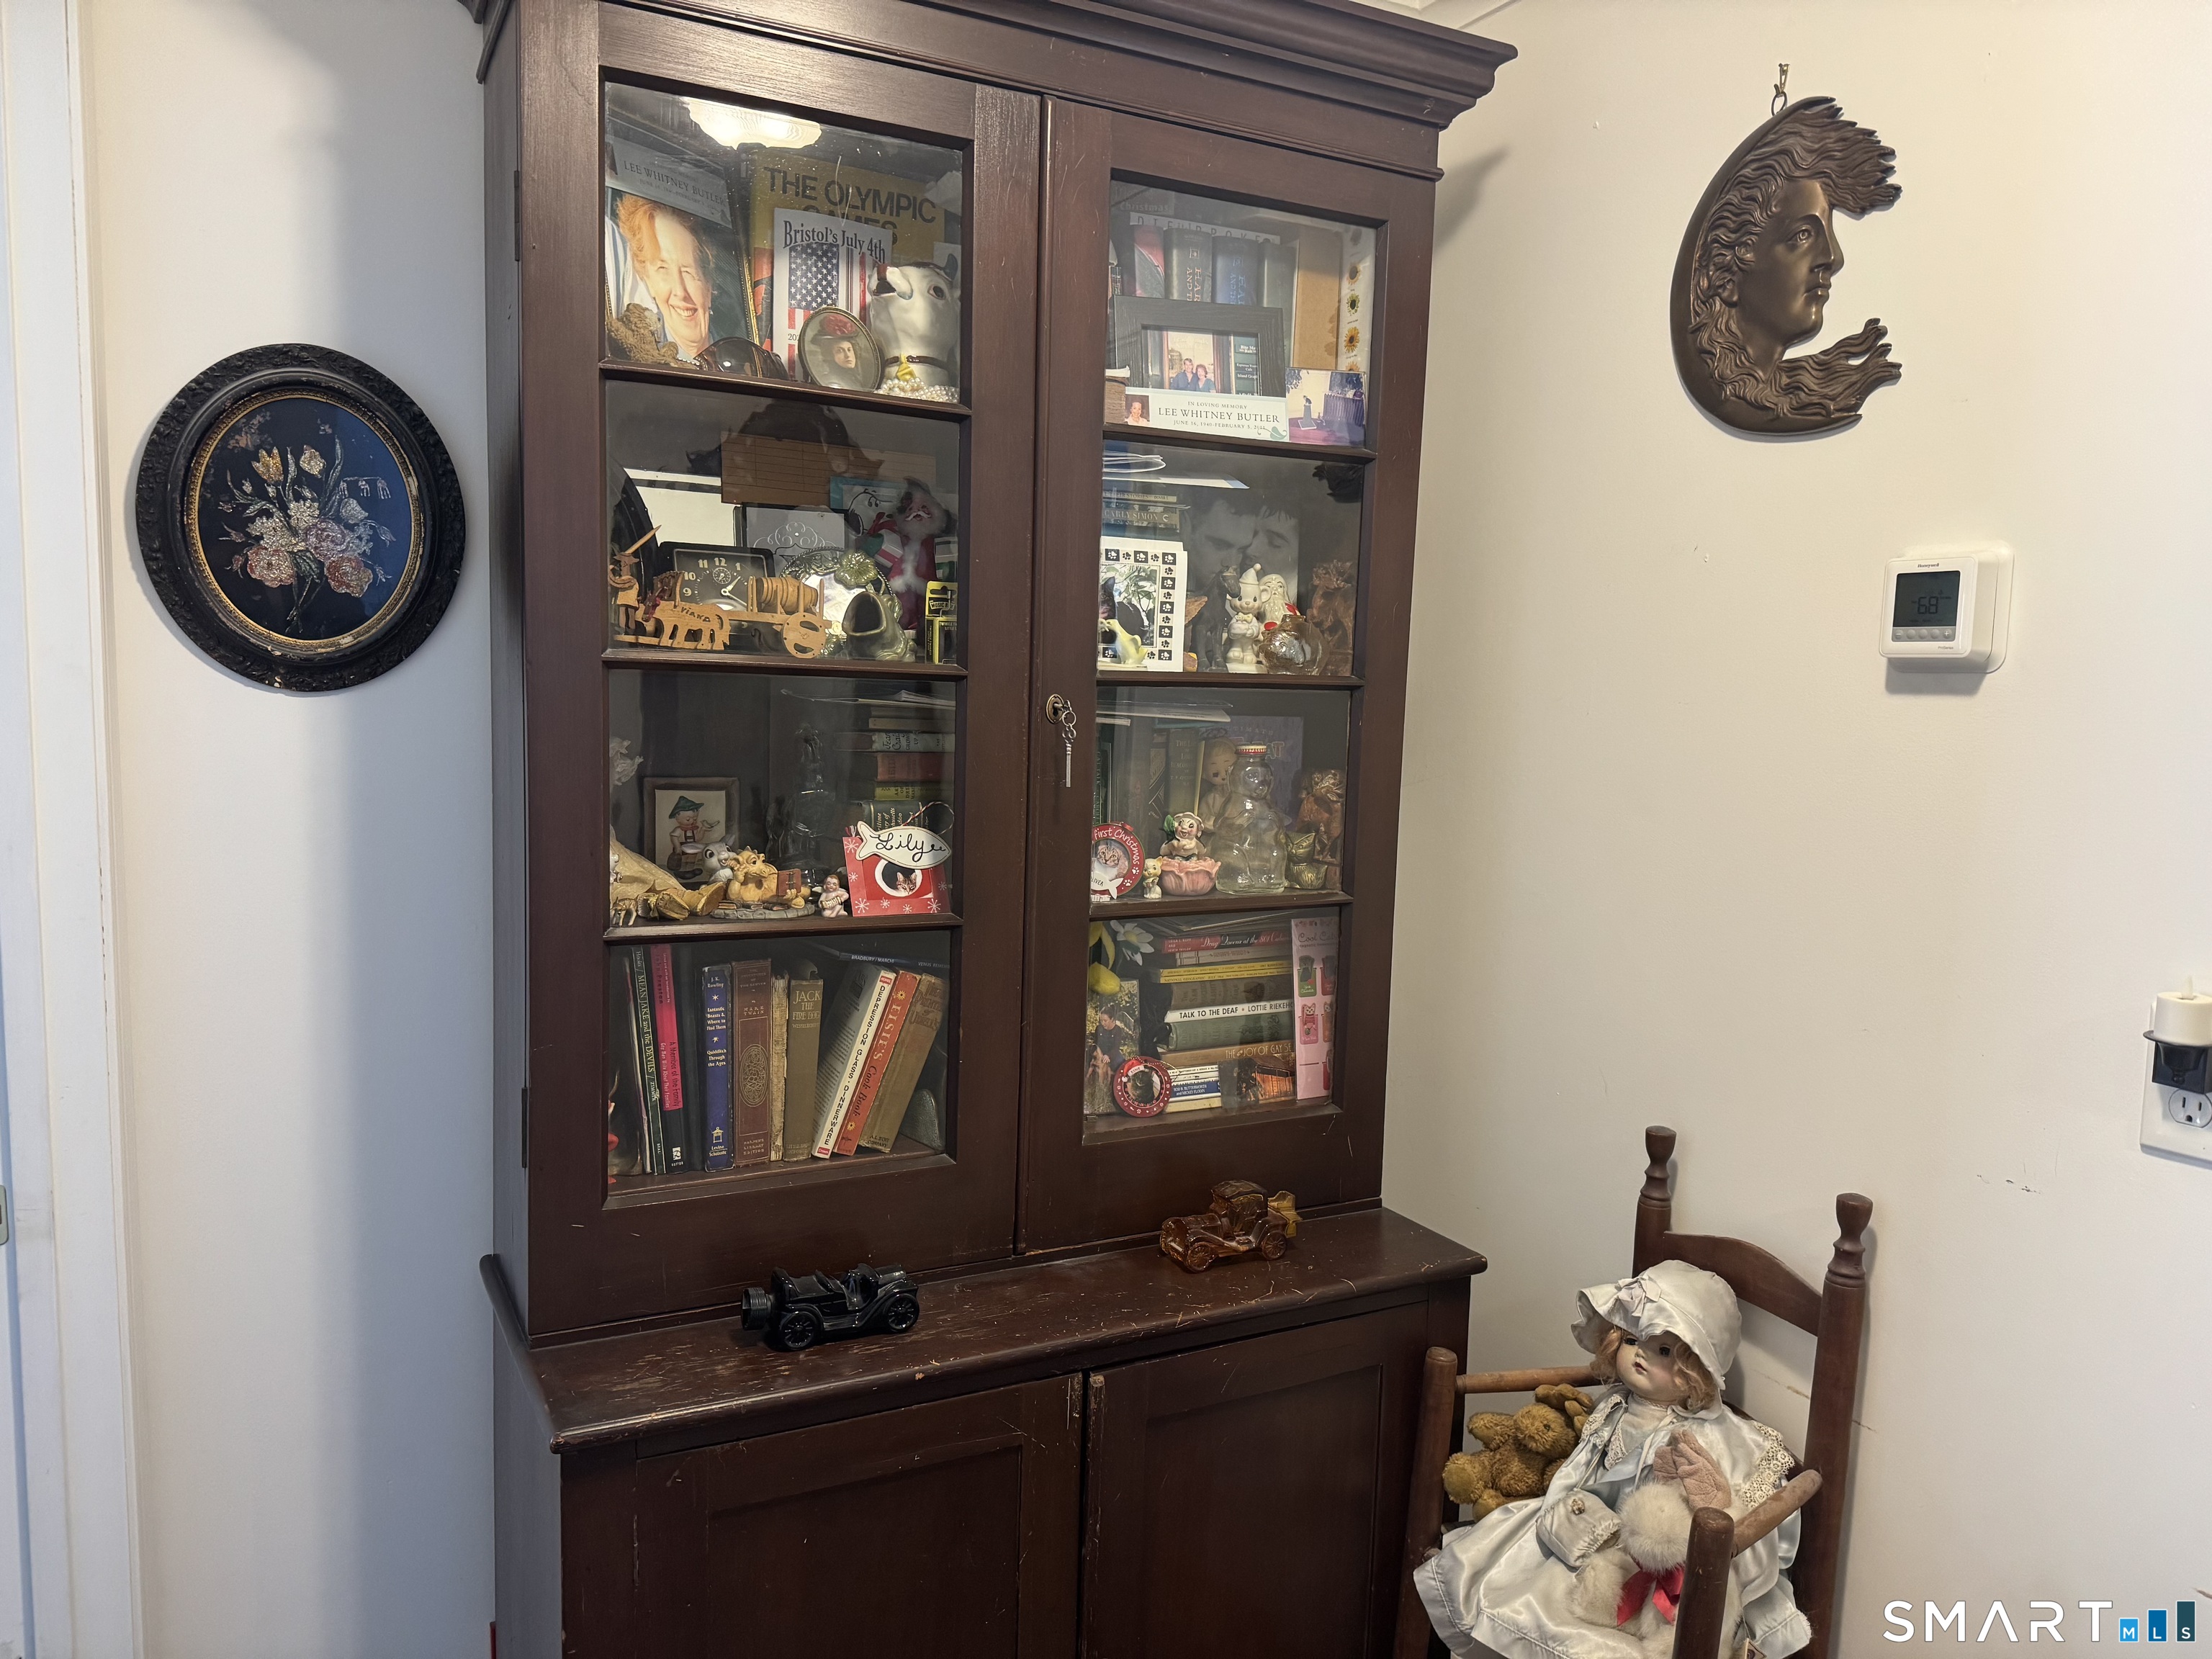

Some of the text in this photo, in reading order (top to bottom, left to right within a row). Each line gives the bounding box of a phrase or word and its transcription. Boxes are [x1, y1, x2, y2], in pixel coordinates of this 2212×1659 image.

[624, 161, 642, 174] LEE
[644, 168, 689, 192] WHITNEY
[764, 166, 818, 201] THE
[824, 180, 936, 223] OLYMPIC
[783, 220, 837, 248] Bristol's
[841, 230, 866, 255] July
[867, 237, 885, 264] 4th
[1159, 408, 1280, 423] LEE WHITNEY BUTLER
[1105, 510, 1130, 518] CARLY
[698, 559, 708, 568] 11
[714, 557, 727, 566] 12
[735, 562, 741, 571] 1
[684, 572, 696, 580] 10
[683, 588, 692, 596] 9
[1917, 595, 1939, 614] 68
[870, 832, 946, 863] Lily
[1114, 830, 1140, 865] Christmas
[1200, 938, 1219, 949] Drag
[1220, 934, 1242, 946] Queens
[1298, 932, 1317, 943] Cool
[637, 975, 646, 998] MEAN
[793, 990, 821, 1004] JACK
[801, 1002, 814, 1010] THE
[639, 999, 649, 1020] JAKE
[860, 985, 886, 1046] DEPRESSION
[645, 1046, 655, 1072] DEVILS
[853, 1002, 902, 1117] ELSIE'S Cook Book
[1226, 1050, 1236, 1059] THE
[1243, 1047, 1256, 1057] JOY
[1258, 1046, 1269, 1054] OF
[1270, 1044, 1282, 1054] GAY
[848, 1049, 863, 1079] GLASS
[824, 1085, 849, 1146] DINNERWARE
